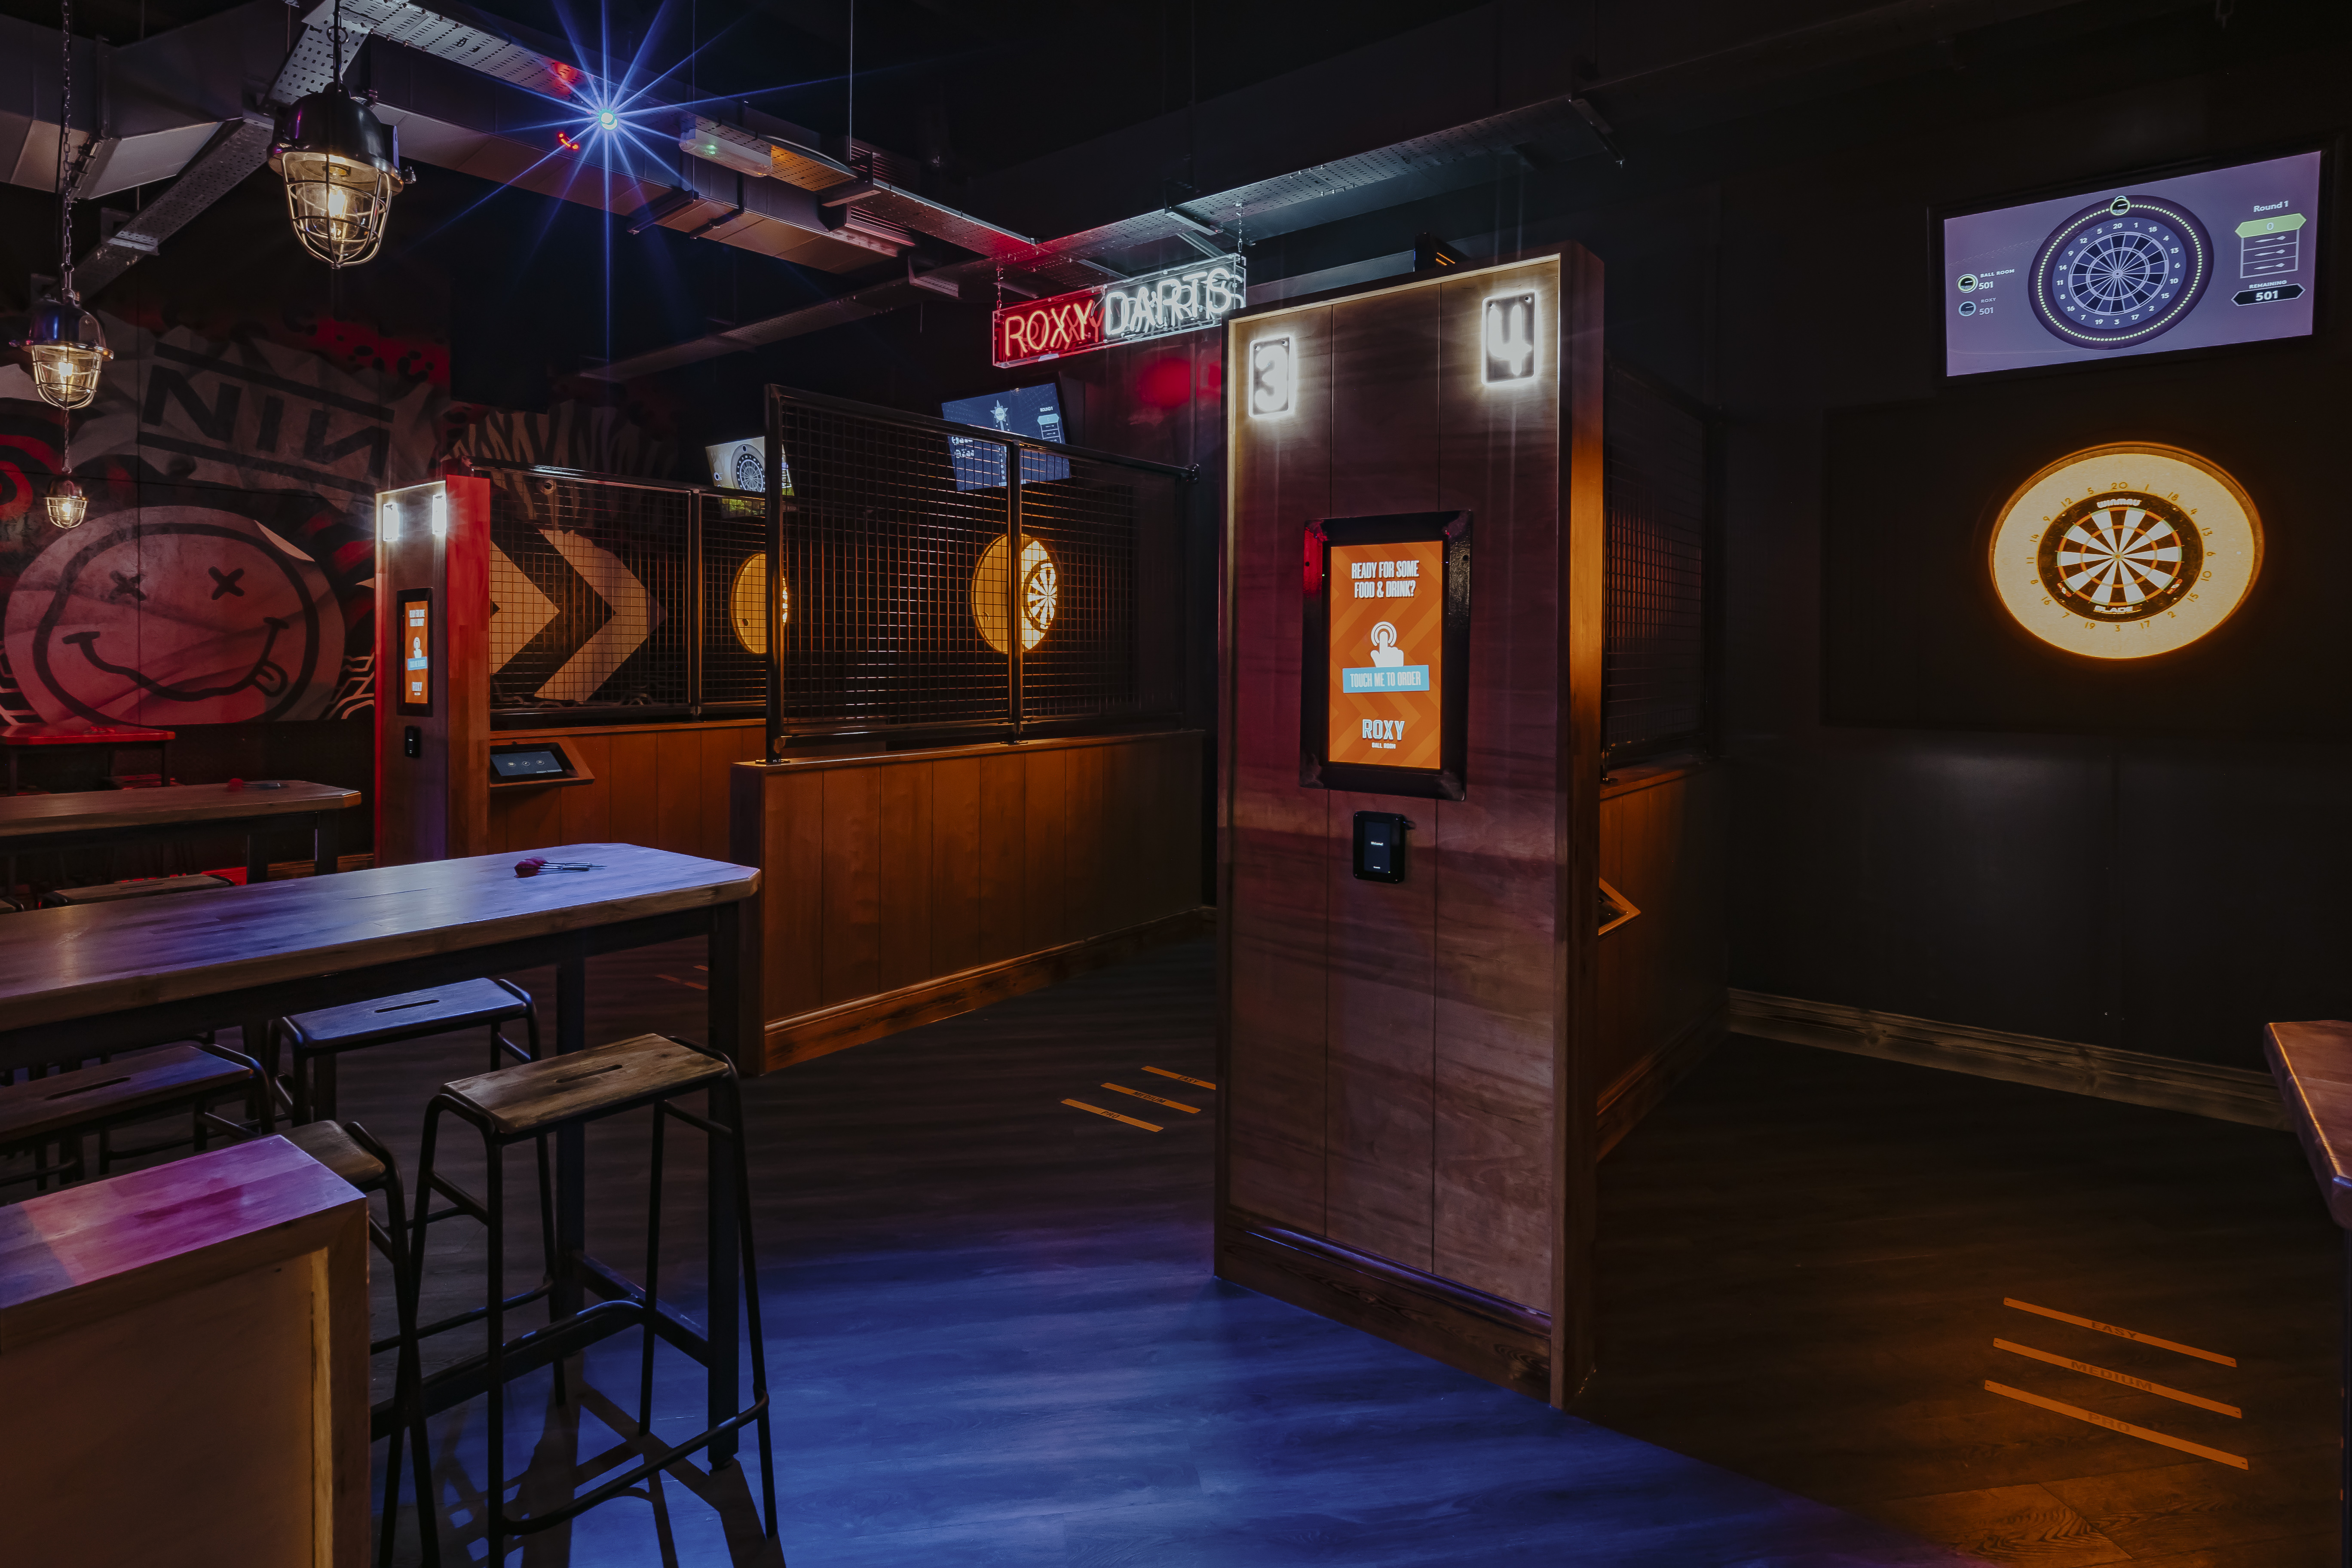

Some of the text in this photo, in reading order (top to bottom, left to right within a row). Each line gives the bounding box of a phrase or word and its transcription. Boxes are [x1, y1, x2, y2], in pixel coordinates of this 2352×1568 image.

[2253, 201, 2283, 212] Round
[2266, 222, 2274, 230] 0
[1978, 281, 1994, 290] 501
[2249, 280, 2288, 289] REMAINING
[2255, 290, 2278, 301] 501
[1004, 268, 1231, 356] ROXY DARTS
[1979, 307, 1994, 315] 501
[1488, 305, 1533, 376] 4
[1255, 345, 1288, 411] 3
[2167, 492, 2179, 501] 18
[2061, 498, 2073, 507] 12
[2201, 527, 2213, 536] 13
[2029, 534, 2040, 542] 14
[1351, 560, 1419, 579] READY FOR SOME
[2200, 571, 2212, 581] 10
[1354, 579, 1416, 598] FOOD & DRINK?
[2040, 596, 2052, 605] 16
[2187, 593, 2199, 602] 15
[2140, 620, 2150, 629] 17
[1350, 671, 1421, 688] TOUCH ME TO ORDER
[1362, 719, 1405, 741] ROXY
[1177, 1075, 1200, 1084] EASY
[1133, 1091, 1167, 1104] MEDIUM
[2091, 1321, 2137, 1338] EASY
[2071, 1361, 2152, 1391] MEDIUM
[2088, 1412, 2129, 1433] PRO
